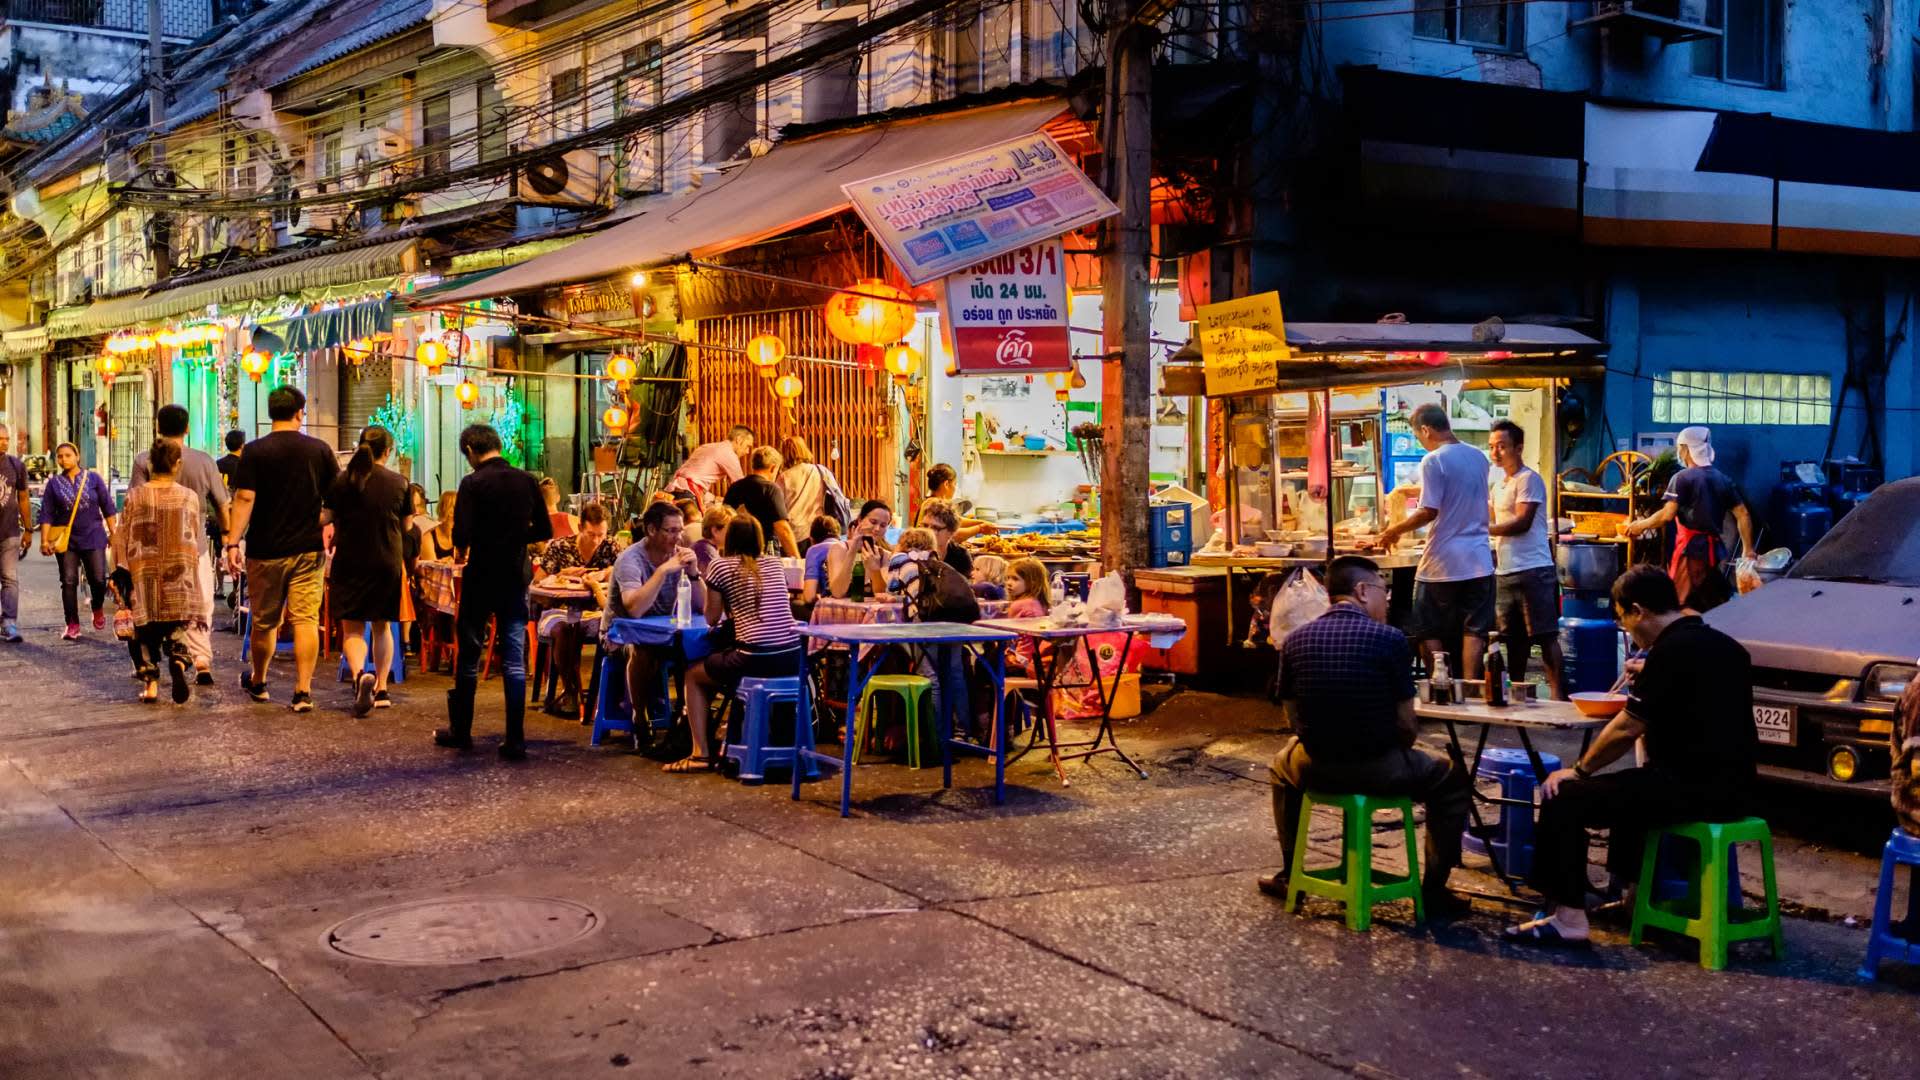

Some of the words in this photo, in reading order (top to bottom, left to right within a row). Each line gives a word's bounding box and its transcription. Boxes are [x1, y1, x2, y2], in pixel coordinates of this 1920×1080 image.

[1020, 245, 1057, 275] 3/1
[971, 278, 993, 299] เปิด
[1000, 283, 1018, 299] 24
[1024, 284, 1046, 299] ชม.
[963, 305, 993, 321] อร่อย
[998, 308, 1012, 325] ถูก
[1018, 304, 1057, 320] ประหยัด
[1756, 708, 1789, 727] 3224
